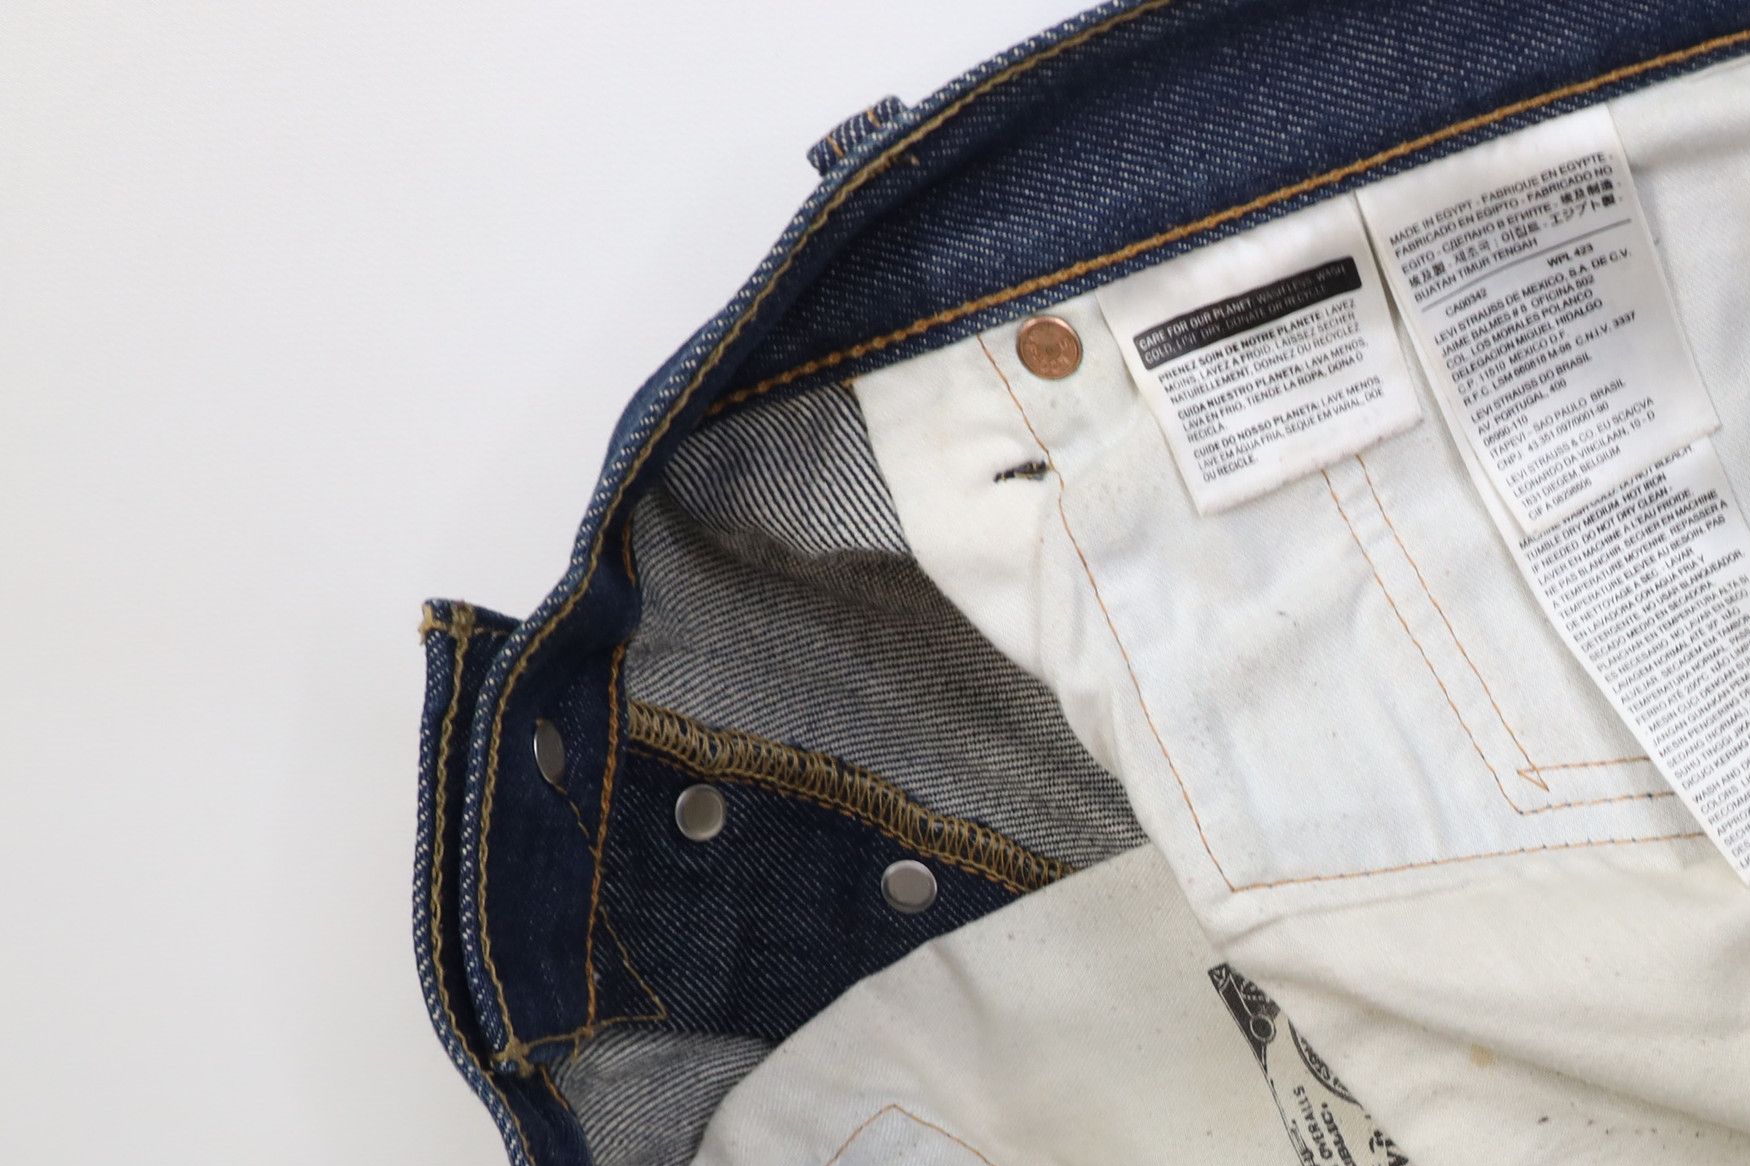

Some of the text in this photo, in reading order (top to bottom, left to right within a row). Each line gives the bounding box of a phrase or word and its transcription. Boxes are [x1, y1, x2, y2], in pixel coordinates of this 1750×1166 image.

[1388, 151, 1605, 246] MADE IN EGYPT FABRIQUE EN EGYPTE
[1393, 164, 1613, 259] FABRICADO EN EGIPTO FABRICADO NO
[1400, 250, 1435, 275] EGITO
[1413, 237, 1538, 303] BUATAN TIMUR TENGAH
[1137, 330, 1167, 350] CARE
[1166, 321, 1190, 339] FOR
[1189, 312, 1212, 330] OUR
[1432, 325, 1458, 346] LEVI
[1456, 298, 1505, 333] STRAUSS
[1504, 291, 1522, 307] DE
[1590, 255, 1608, 269] DE
[1439, 333, 1471, 358] JAIME
[1469, 311, 1511, 341] BALMES
[1529, 282, 1574, 310] OFICINA
[1469, 337, 1492, 357] LOS
[1491, 311, 1541, 345] MORALES
[1540, 288, 1594, 318] POLANCO
[1514, 320, 1553, 347] MIGUEL
[1554, 297, 1603, 327] HIDALGO
[1156, 359, 1197, 383] PRENEZ
[1197, 348, 1223, 366] SOIN
[1223, 342, 1240, 356] DE
[1239, 328, 1275, 350] NOTRE
[1324, 297, 1355, 317] LAVEZ
[1252, 348, 1295, 372] DONNEZ
[1295, 341, 1312, 355] OU
[1312, 321, 1360, 348] RECYCLEZ
[1176, 401, 1206, 420] CUIDA
[1206, 382, 1254, 408] NUESTRO
[1304, 351, 1329, 369] LAVA
[1470, 350, 1592, 424] LEVI STRAUSS DO BRASIL
[1547, 378, 1568, 394] 400
[1192, 441, 1219, 459] CUIDE
[1220, 434, 1236, 447] DO
[1236, 419, 1272, 441] NOSSO
[1320, 389, 1345, 407] LAVE
[1524, 533, 1563, 562] TUMBLE
[1560, 521, 1583, 541] DRY
[1621, 484, 1643, 505] HOT
[1641, 470, 1667, 492] IRON
[1529, 562, 1542, 575] IF
[1580, 529, 1596, 545] DO
[1595, 516, 1617, 536] NOT
[1615, 503, 1638, 524] DRY
[1636, 484, 1669, 511] CLEAN
[1691, 779, 1721, 805] WASH
[1718, 764, 1741, 785] AND
[1291, 1084, 1334, 1161] OVERALLS
